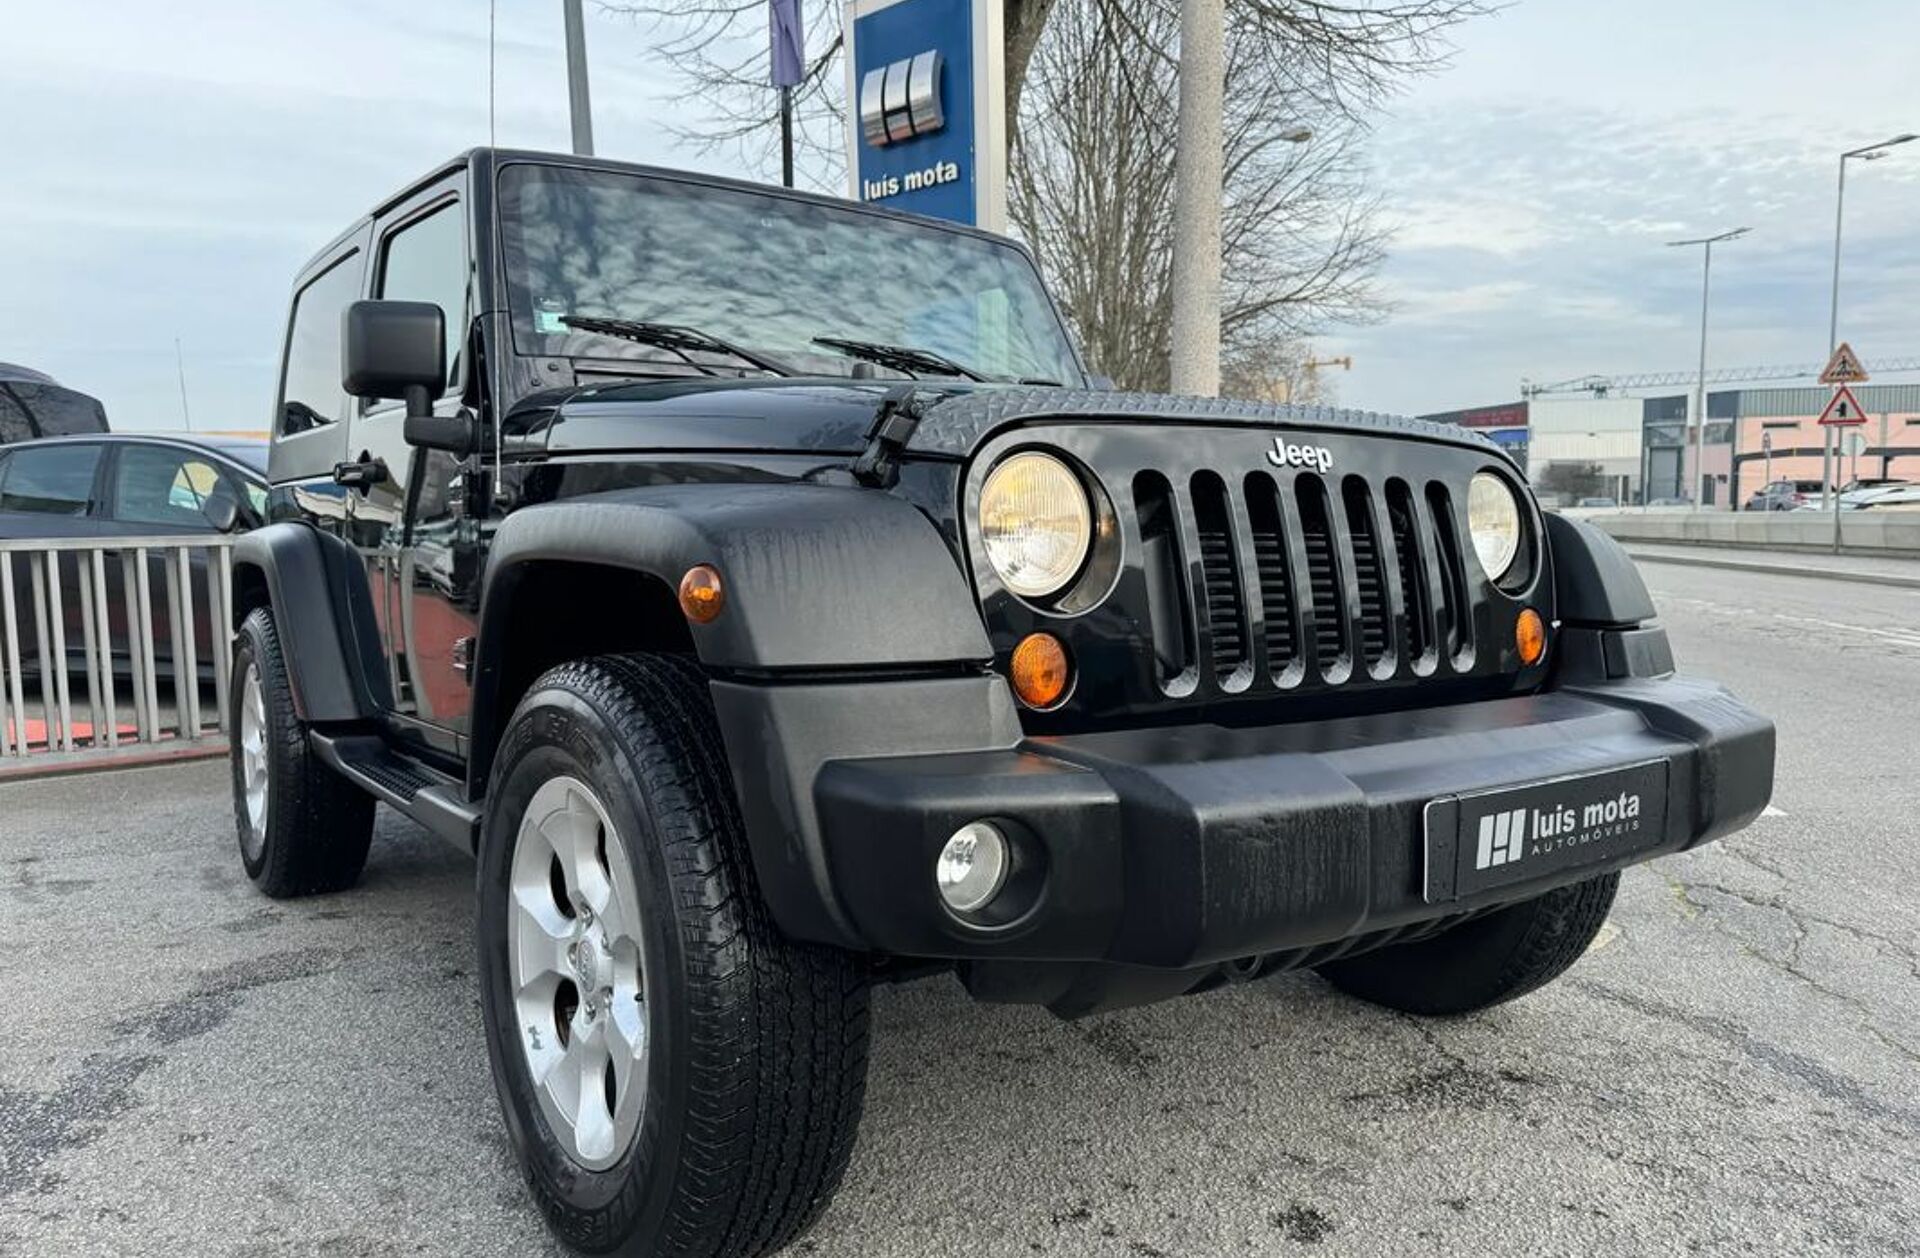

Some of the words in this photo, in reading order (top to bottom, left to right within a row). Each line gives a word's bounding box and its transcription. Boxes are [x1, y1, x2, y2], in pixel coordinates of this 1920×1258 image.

[864, 174, 900, 200] luis
[904, 161, 959, 191] mota
[1266, 437, 1334, 475] Jeep
[1532, 804, 1576, 840] luis
[1583, 791, 1640, 828] mota
[1532, 819, 1640, 856] AUTOMÓVEIS
